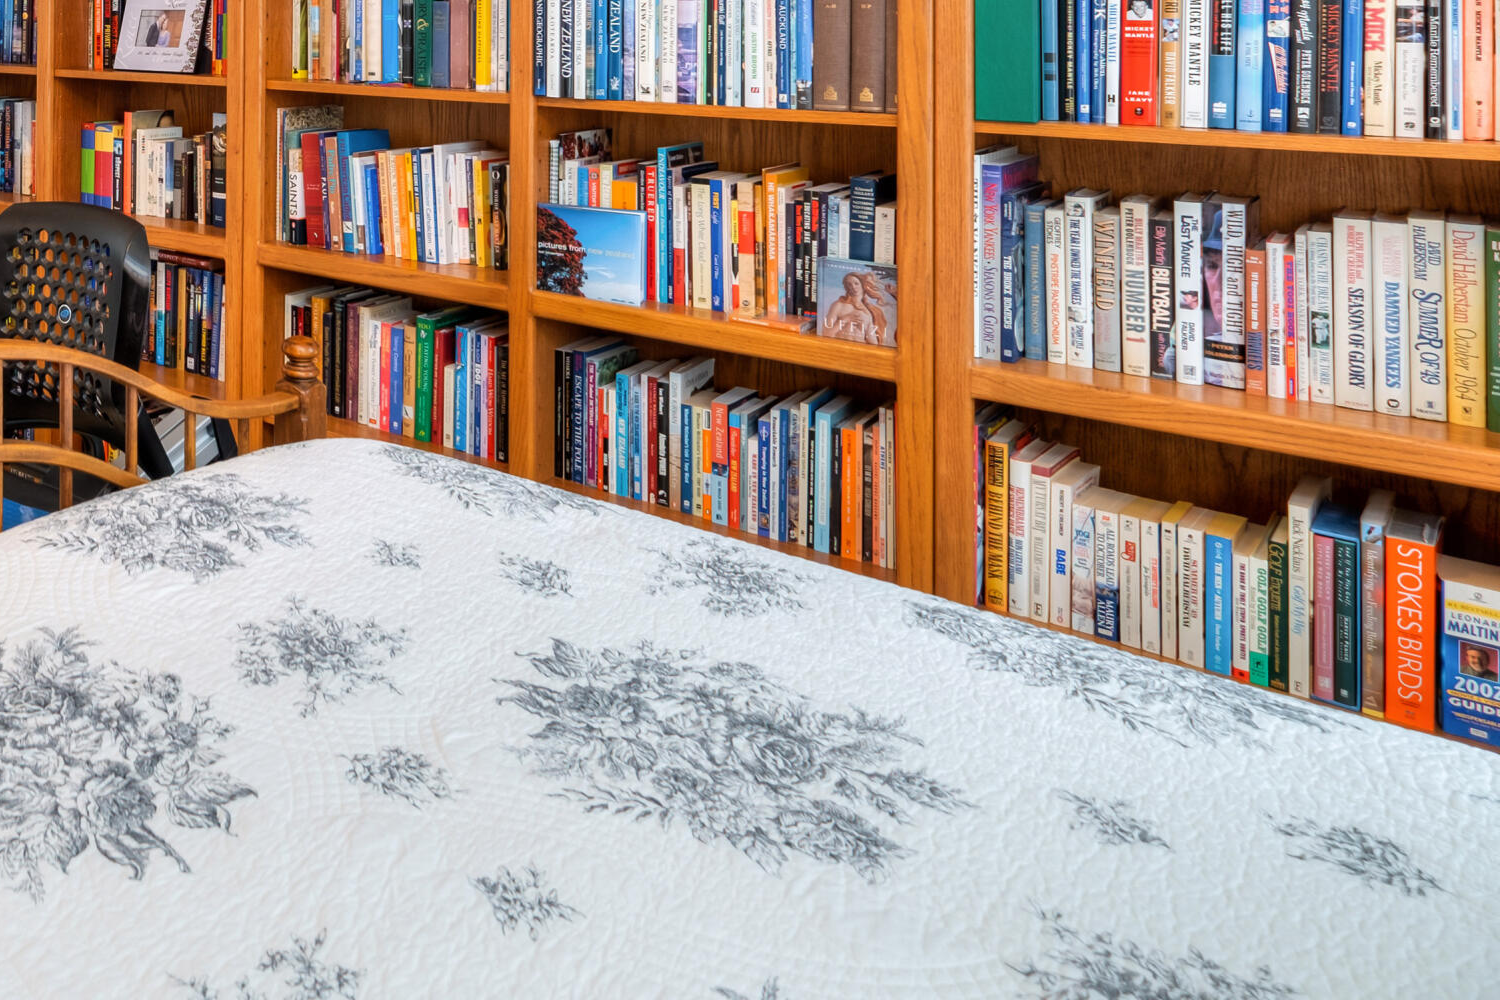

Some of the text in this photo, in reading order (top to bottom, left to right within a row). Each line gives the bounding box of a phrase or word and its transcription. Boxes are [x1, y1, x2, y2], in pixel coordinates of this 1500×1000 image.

[562, 0, 571, 24] NEW
[609, 1, 620, 52] ZEALAND
[779, 5, 787, 49] AUCKLAND
[1221, 13, 1232, 28] HIS
[1365, 8, 1385, 51] MICK
[418, 33, 427, 72] PRAISE
[535, 16, 543, 66] GEOGRAPHIC
[561, 27, 571, 77] ZEALAND
[1221, 32, 1232, 51] LIFE
[1301, 50, 1311, 68] PETER
[1327, 5, 1340, 92] MICKEY MANTLE
[1430, 16, 1440, 107] Mantle Remembered
[1189, 43, 1201, 86] MANTLE
[1372, 61, 1383, 105] Mickey Mantle
[290, 174, 298, 216] SAINTS
[647, 172, 655, 222] TRUERED
[538, 241, 585, 252] pictures from
[984, 182, 998, 343] NEW YORK YANKEES SEASONS OF GLORY
[1070, 219, 1082, 304] THE YEAR OWNED THE YANKEES
[1094, 220, 1116, 310] WINFIELD
[1153, 226, 1166, 265] Billy Martin
[1181, 215, 1194, 278] LAST YANKEE
[1412, 225, 1427, 281] HALBERSTAM
[1427, 241, 1441, 266] DAVID
[1031, 245, 1039, 334] THURMAN MUNSON
[1225, 210, 1243, 335] WILD, HIGH and TIGHT
[1004, 272, 1012, 329] BRONX BOMBERS
[1051, 254, 1060, 345] PINSTRIPE PANDEMONIUM
[1125, 269, 1146, 332] NUMBER
[1151, 268, 1170, 329] BILLYBALL
[1347, 287, 1364, 331] SEASON
[1384, 281, 1400, 334] DAMNED
[1452, 230, 1478, 401] David Halberstam October 1964
[824, 318, 887, 337] UFFIZI
[1348, 334, 1364, 348] OF
[1412, 289, 1443, 367] SUMMER OF
[1247, 332, 1263, 371] YANKEES
[1348, 351, 1365, 389] GLORY
[1385, 336, 1401, 389] YANKEES
[574, 375, 582, 409] ESCAPE
[574, 426, 582, 444] THE
[575, 412, 582, 423] TO
[715, 428, 724, 459] Zealand
[988, 491, 1003, 529] BEHIND
[988, 531, 1003, 551] THE
[1055, 548, 1066, 575] BABE
[1097, 543, 1105, 577] OCTOBER
[1106, 528, 1115, 585] ALL ROADS LEAD
[1268, 544, 1285, 576] GOLF
[1292, 517, 1305, 605] Jack Nicklaus Golf
[988, 552, 1003, 580] MASK
[1097, 598, 1106, 626] ALLEN
[1105, 600, 1115, 631] MAURY
[1183, 573, 1191, 627] HALBERSTAM
[1257, 568, 1266, 654] GOLF GOLF GOLF
[1364, 549, 1377, 651] Identifying Feeding Birds
[1397, 545, 1422, 702] STOKES BIRDS
